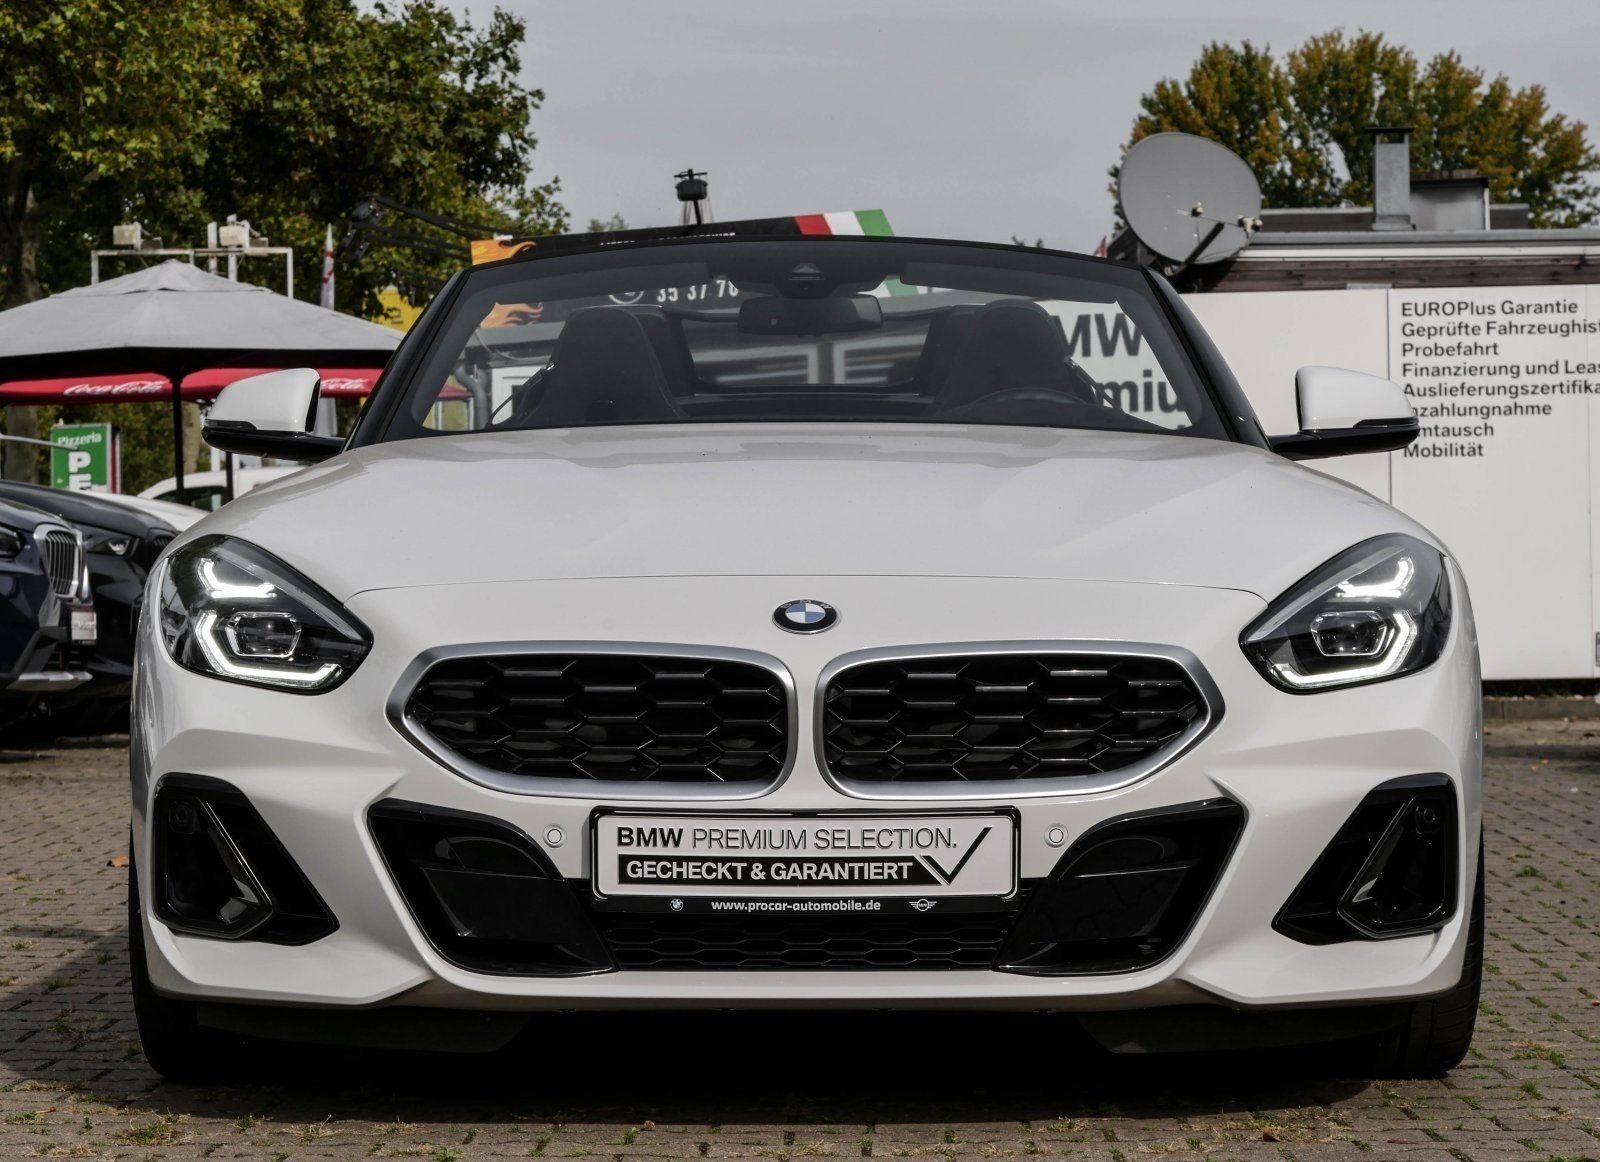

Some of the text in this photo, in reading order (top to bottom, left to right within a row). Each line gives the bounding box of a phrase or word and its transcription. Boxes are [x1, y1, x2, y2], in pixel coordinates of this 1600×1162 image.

[1401, 299, 1578, 317] EUROPlus Garantie
[1401, 322, 1481, 339] Geprüfte
[1402, 341, 1499, 357] Probefahrt
[1402, 361, 1520, 379] Finanzierung
[1525, 360, 1559, 375] und
[1411, 402, 1552, 420] nzahlungnahme
[1418, 423, 1494, 438] mtausch
[57, 432, 102, 447] Pizzeria
[1403, 443, 1484, 458] Mobilität
[617, 826, 957, 849] BMW PREMIUM SELECTION.
[626, 860, 913, 880] GECHECKT & GARANTIERT
[711, 901, 881, 912] www.procar-automobile.de
